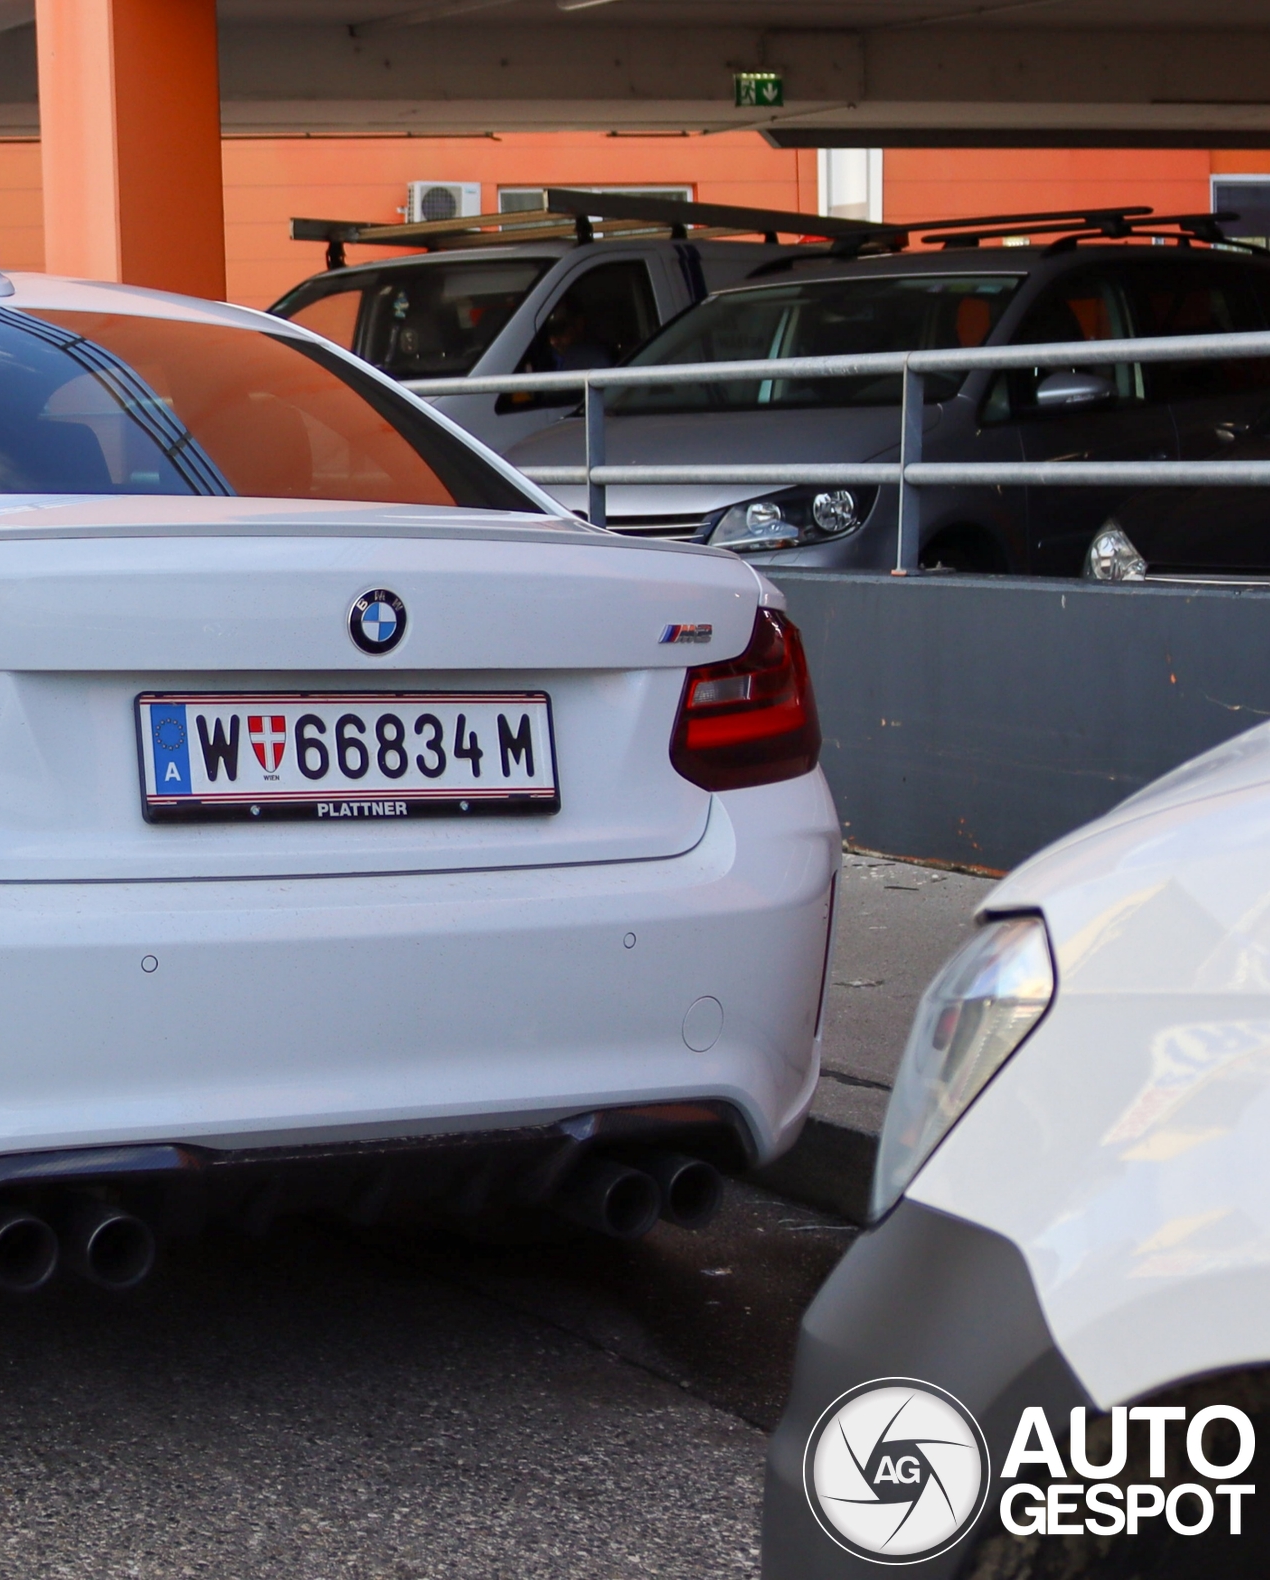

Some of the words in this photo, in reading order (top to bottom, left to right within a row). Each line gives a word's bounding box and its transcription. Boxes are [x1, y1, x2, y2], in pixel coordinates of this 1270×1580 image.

[356, 590, 403, 611] BMW
[196, 714, 240, 782] W
[295, 713, 484, 780] 66834
[497, 713, 535, 778] M
[165, 761, 182, 782] A
[317, 801, 408, 817] PLATTNER
